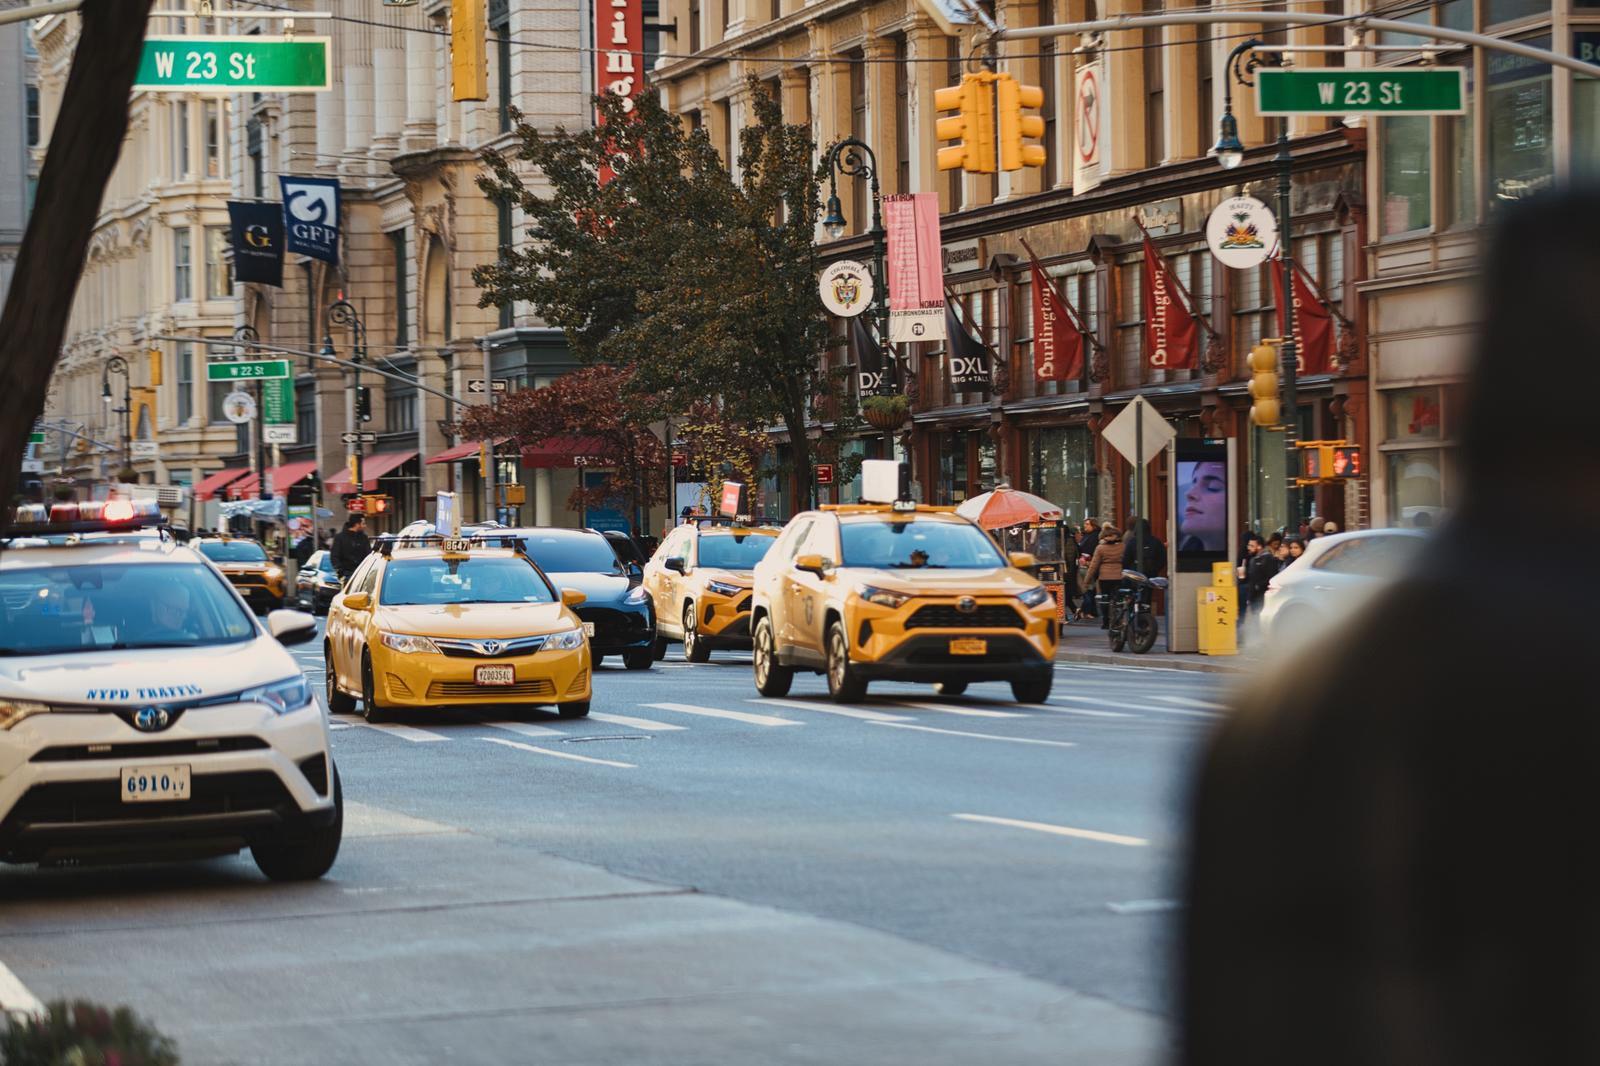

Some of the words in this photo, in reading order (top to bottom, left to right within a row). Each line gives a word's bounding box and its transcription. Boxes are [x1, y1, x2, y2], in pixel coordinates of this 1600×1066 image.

[155, 51, 175, 78] W
[186, 51, 217, 79] 23
[229, 52, 256, 80] St
[1317, 81, 1336, 105] W
[1343, 81, 1371, 105] 23
[1379, 81, 1402, 105] St
[884, 194, 915, 202] FLATIRON
[245, 224, 272, 247] G
[292, 224, 336, 245] GFP
[830, 265, 860, 276] COLOMBIA
[891, 309, 944, 318] FLATIRONNOMAD.NYC
[920, 300, 944, 309] NOMAD
[1150, 270, 1171, 366] Burlington
[1038, 287, 1056, 377] Burlington
[230, 367, 238, 376] W
[241, 366, 252, 376] 22
[255, 365, 264, 375] St
[949, 357, 988, 376] DXL
[446, 541, 468, 550] 8G47
[86, 688, 130, 700] NYPD
[136, 684, 202, 699] TRAFFIC
[127, 774, 170, 793] 6910
